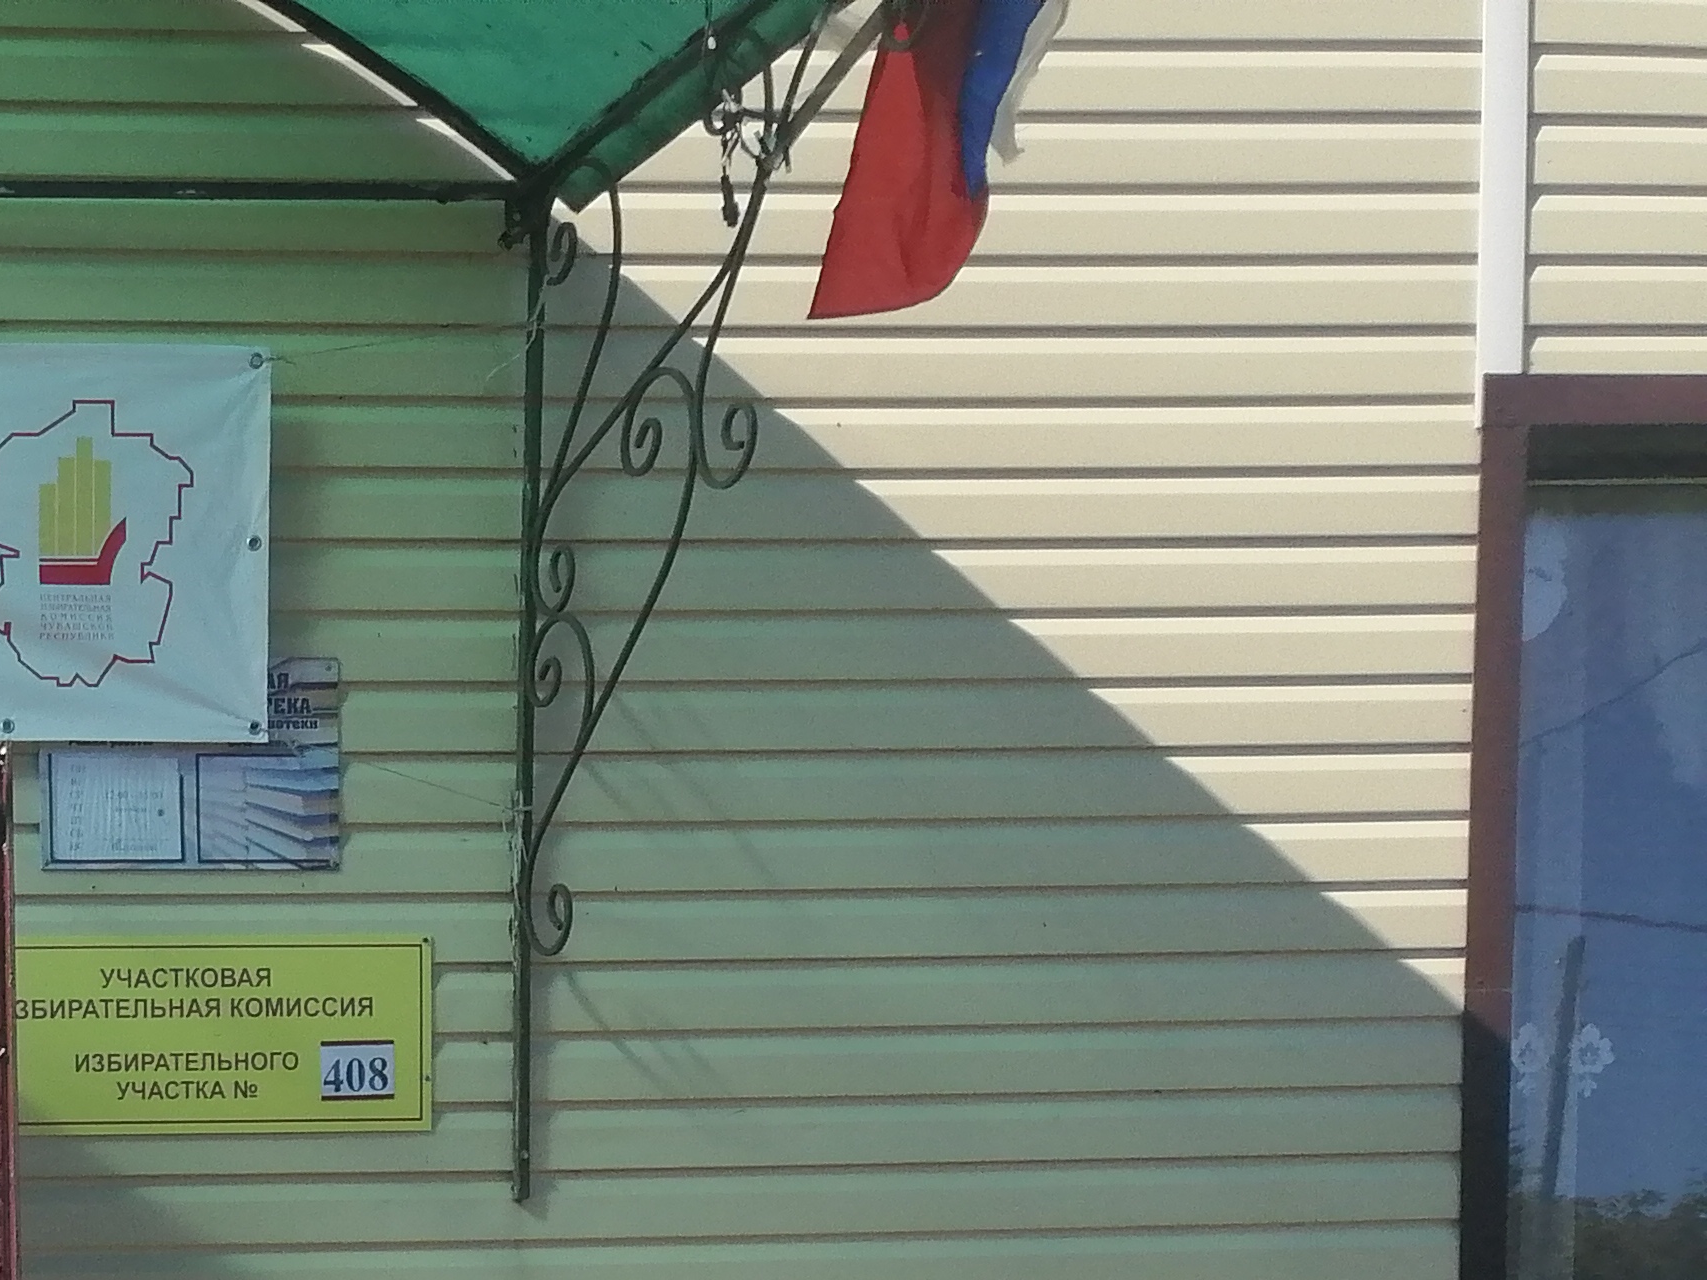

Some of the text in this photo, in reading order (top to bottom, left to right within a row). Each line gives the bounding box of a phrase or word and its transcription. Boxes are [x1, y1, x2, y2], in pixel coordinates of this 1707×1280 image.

[100, 967, 272, 989] УЧАСТКОВАЯ
[14, 996, 374, 1020] ЗБИРАТЕЛЬНАЯ КОМИССИЯ
[74, 1051, 300, 1073] ИЗБИРАТЕЛЬНОГО
[116, 1056, 389, 1101] УЧАСТКА № 408
